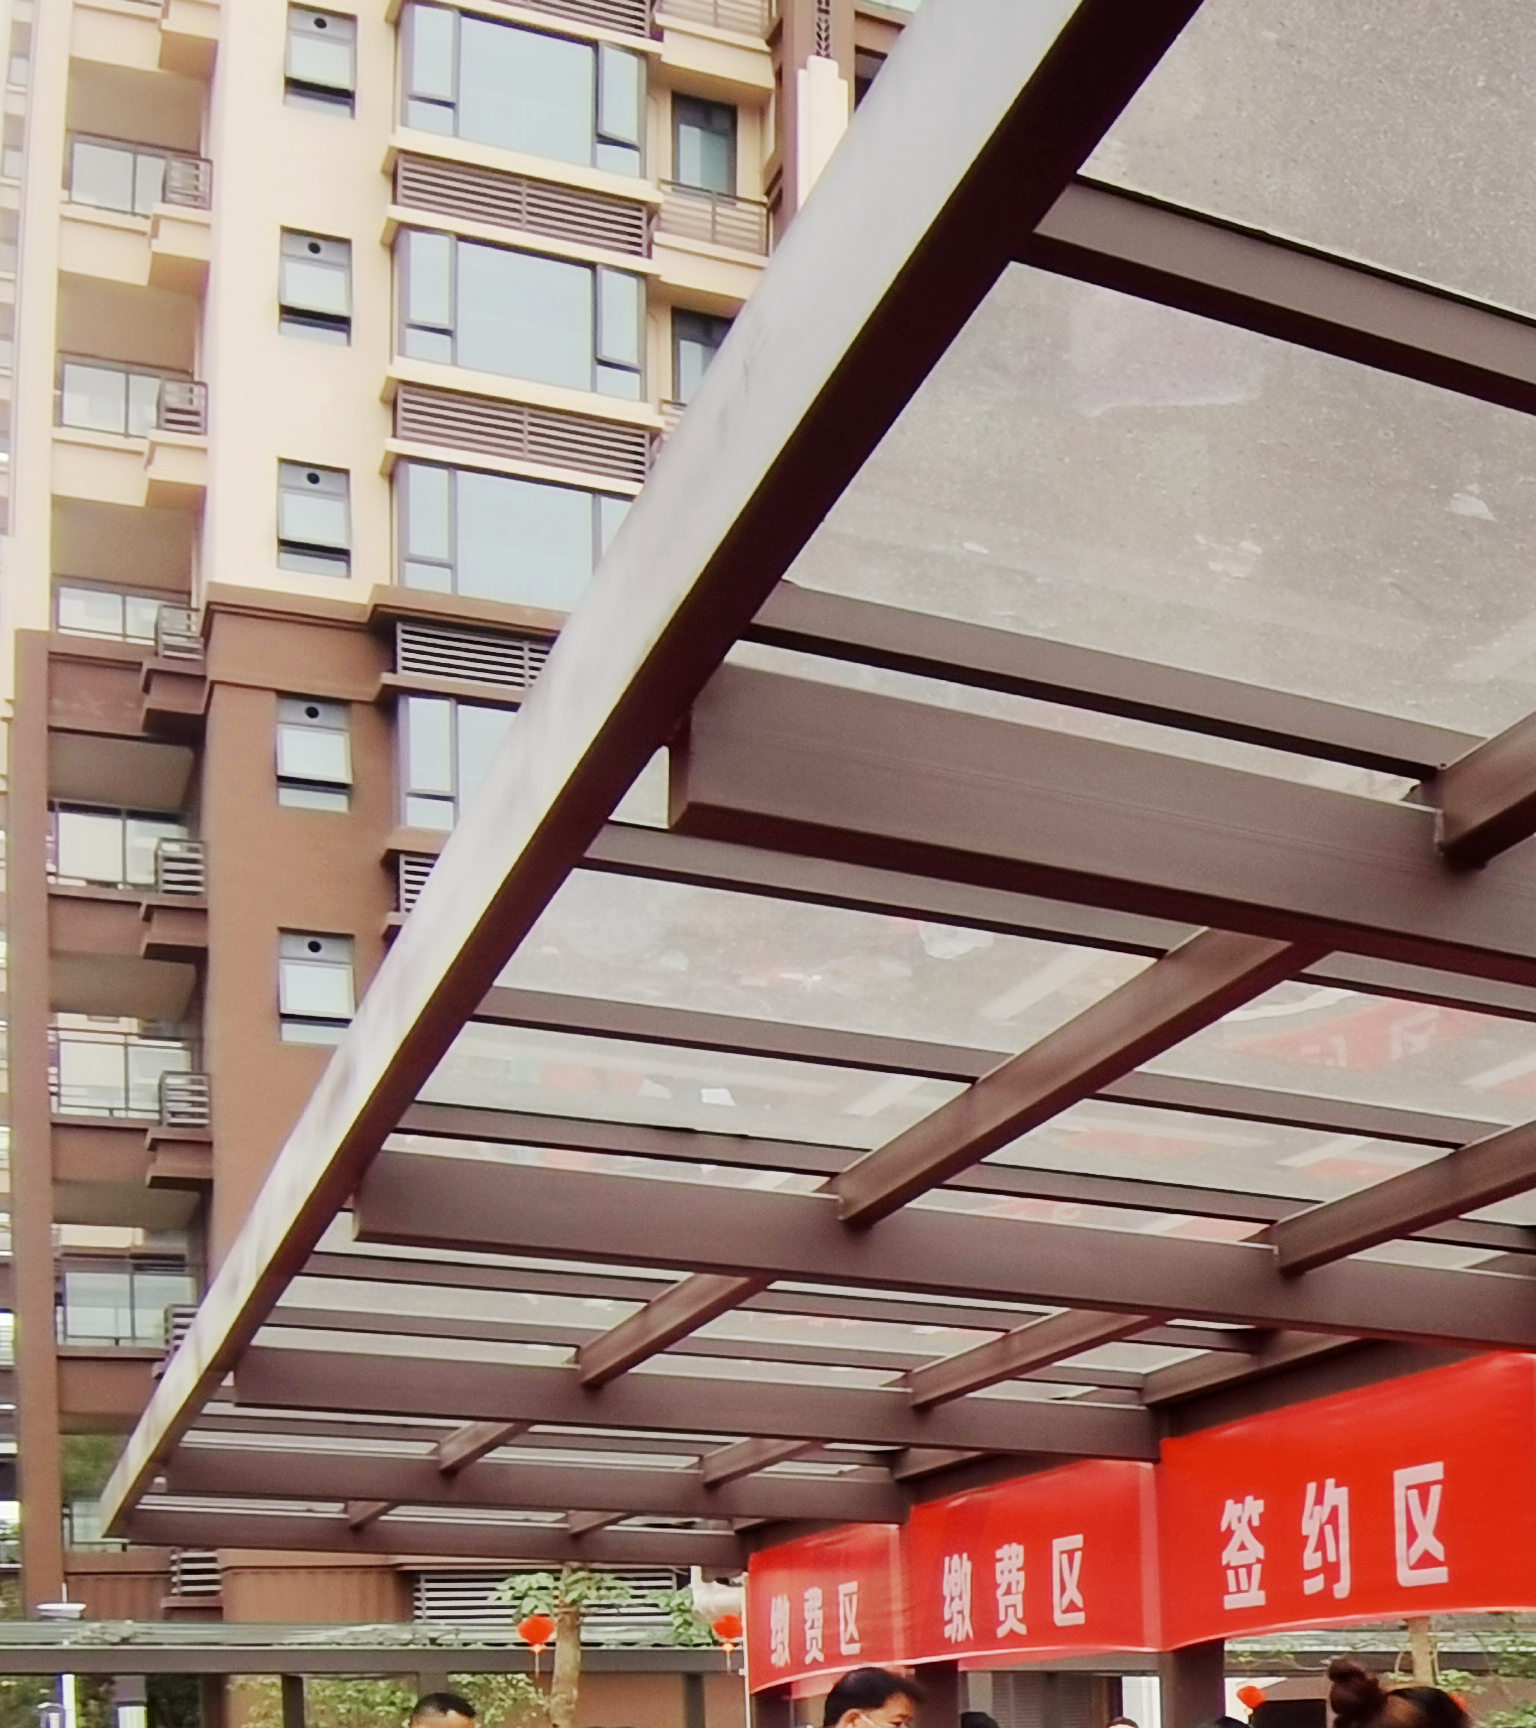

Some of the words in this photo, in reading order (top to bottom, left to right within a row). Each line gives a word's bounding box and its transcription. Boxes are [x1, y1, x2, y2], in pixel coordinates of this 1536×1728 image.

[942, 1534, 1086, 1644] 缴费区
[1220, 1460, 1450, 1612] 签约区
[769, 1580, 862, 1668] 缴费区
